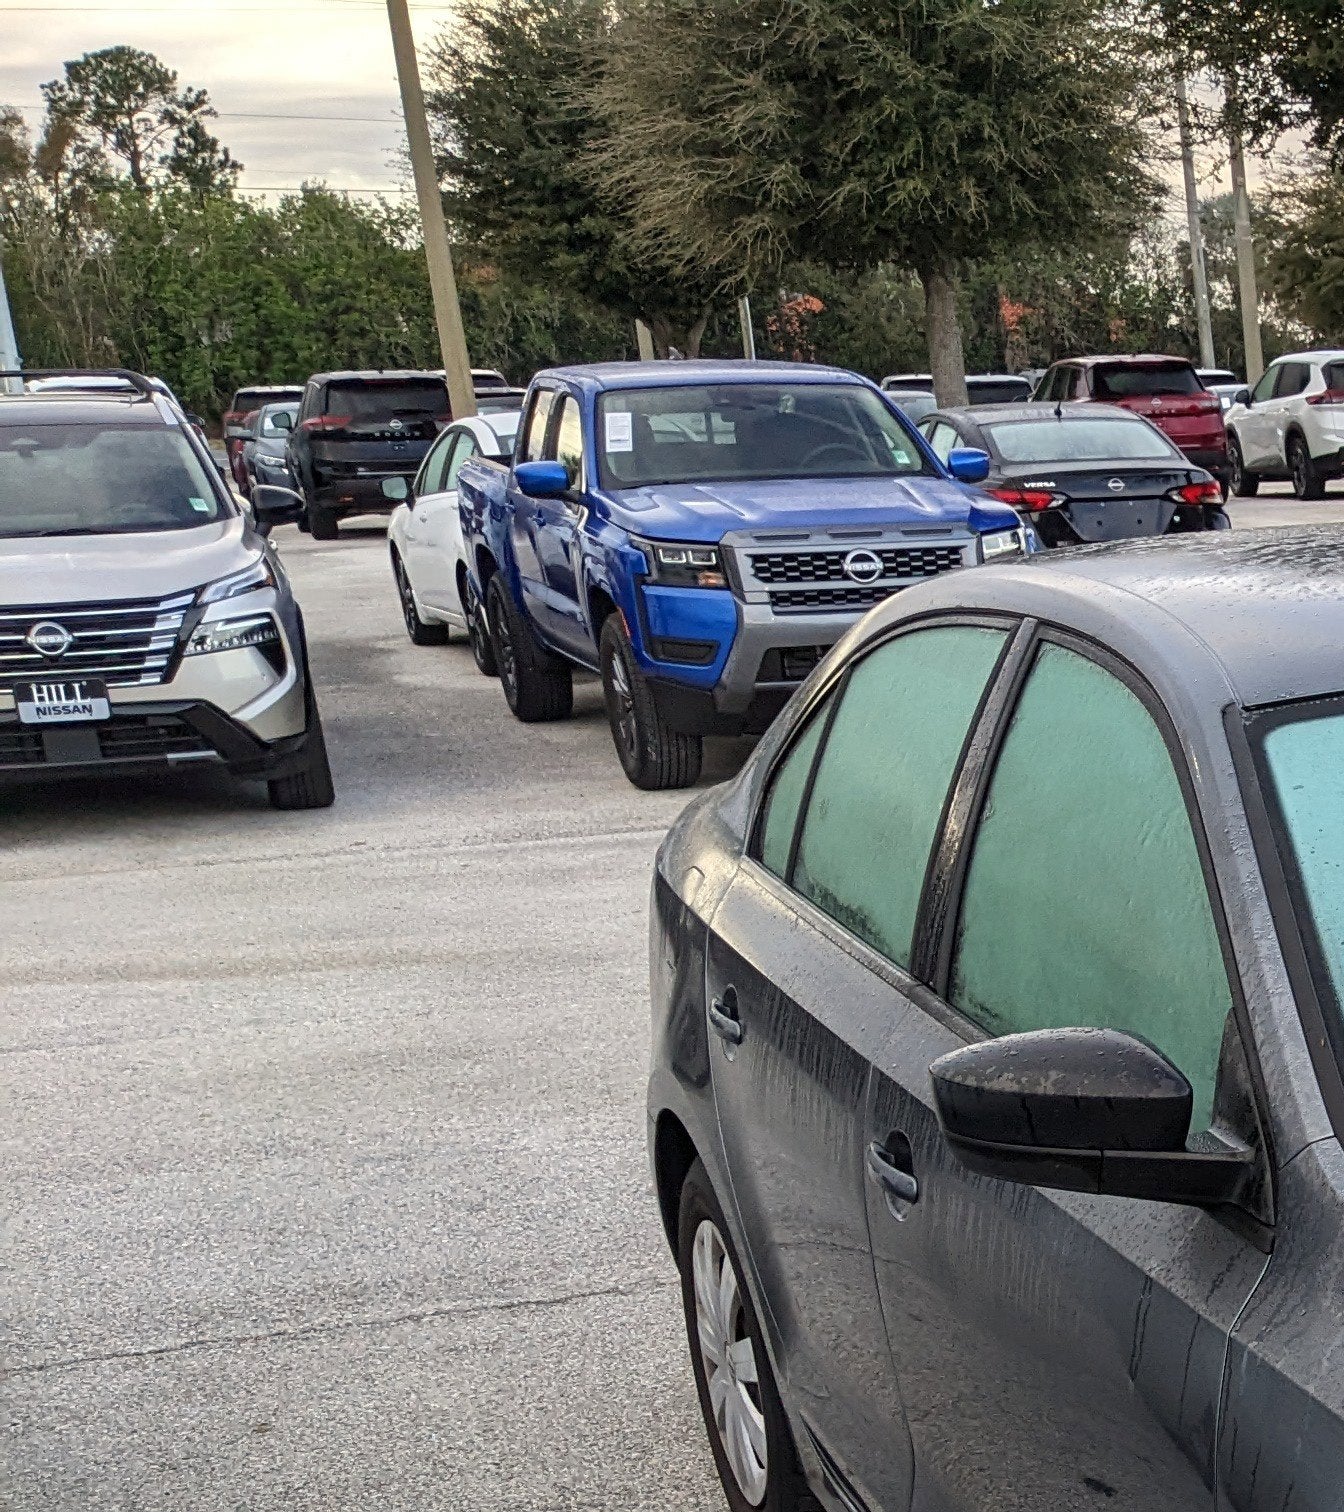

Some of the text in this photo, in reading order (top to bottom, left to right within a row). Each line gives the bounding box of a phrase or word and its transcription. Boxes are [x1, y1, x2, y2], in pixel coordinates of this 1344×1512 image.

[843, 562, 884, 571] NISSAN
[27, 635, 73, 645] NISSAN
[30, 683, 92, 705] HILL
[35, 704, 93, 716] NISSAN
